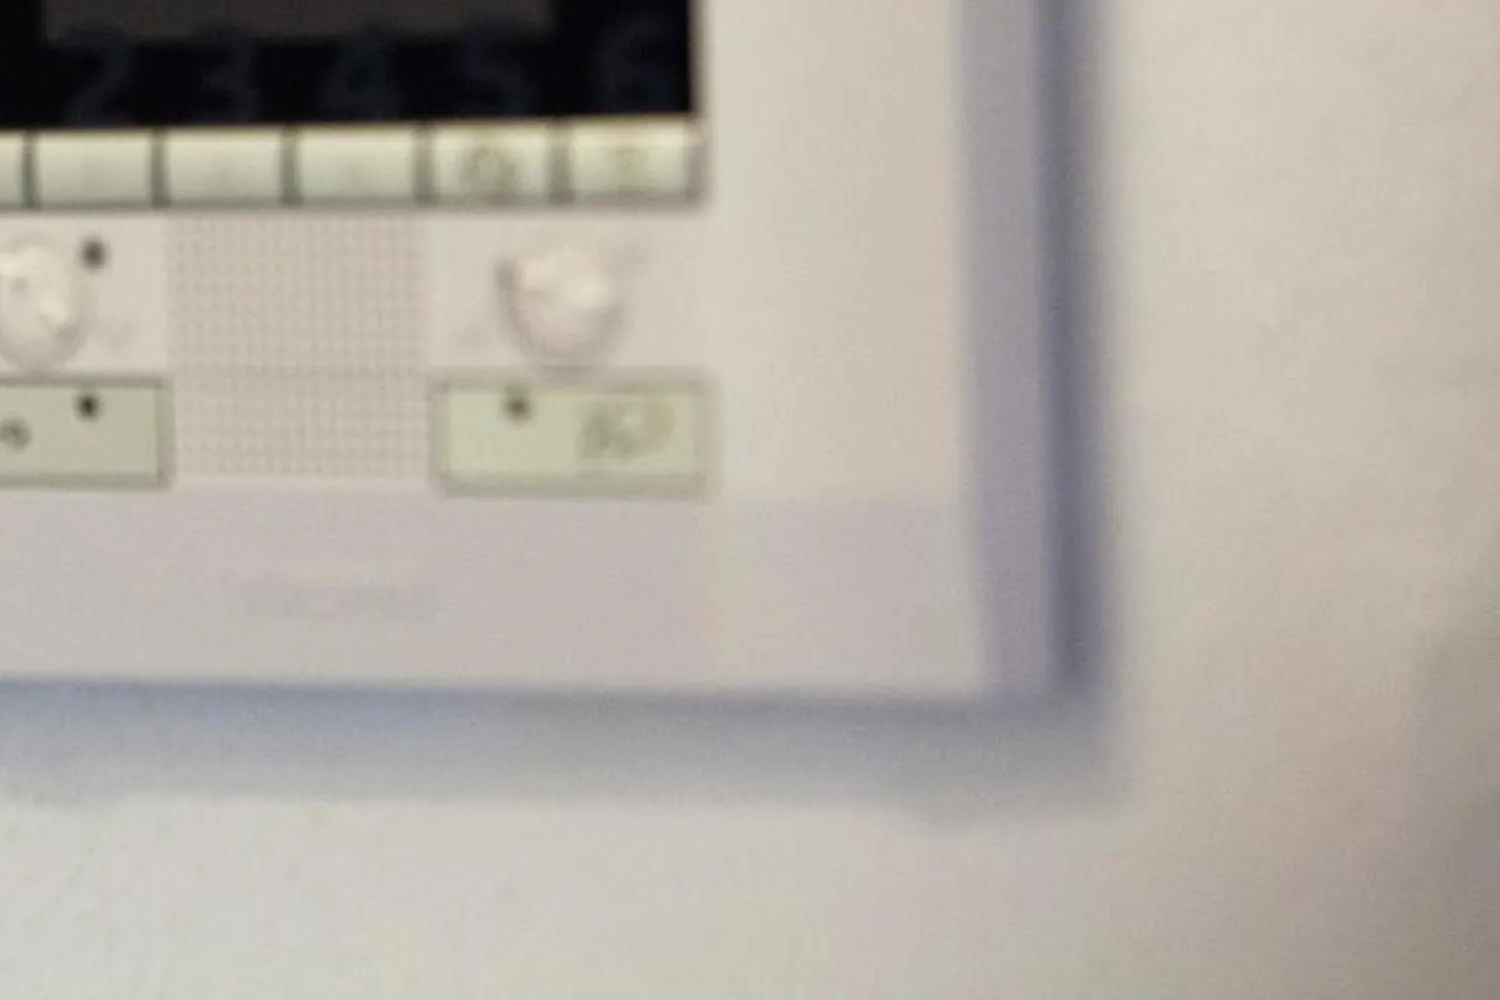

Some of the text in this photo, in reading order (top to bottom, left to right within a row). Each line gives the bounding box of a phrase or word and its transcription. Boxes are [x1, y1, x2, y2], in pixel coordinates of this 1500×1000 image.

[62, 25, 136, 124] 2
[200, 24, 264, 122] 3
[318, 22, 400, 119] 4
[457, 20, 536, 118] 5
[592, 12, 678, 114] 6
